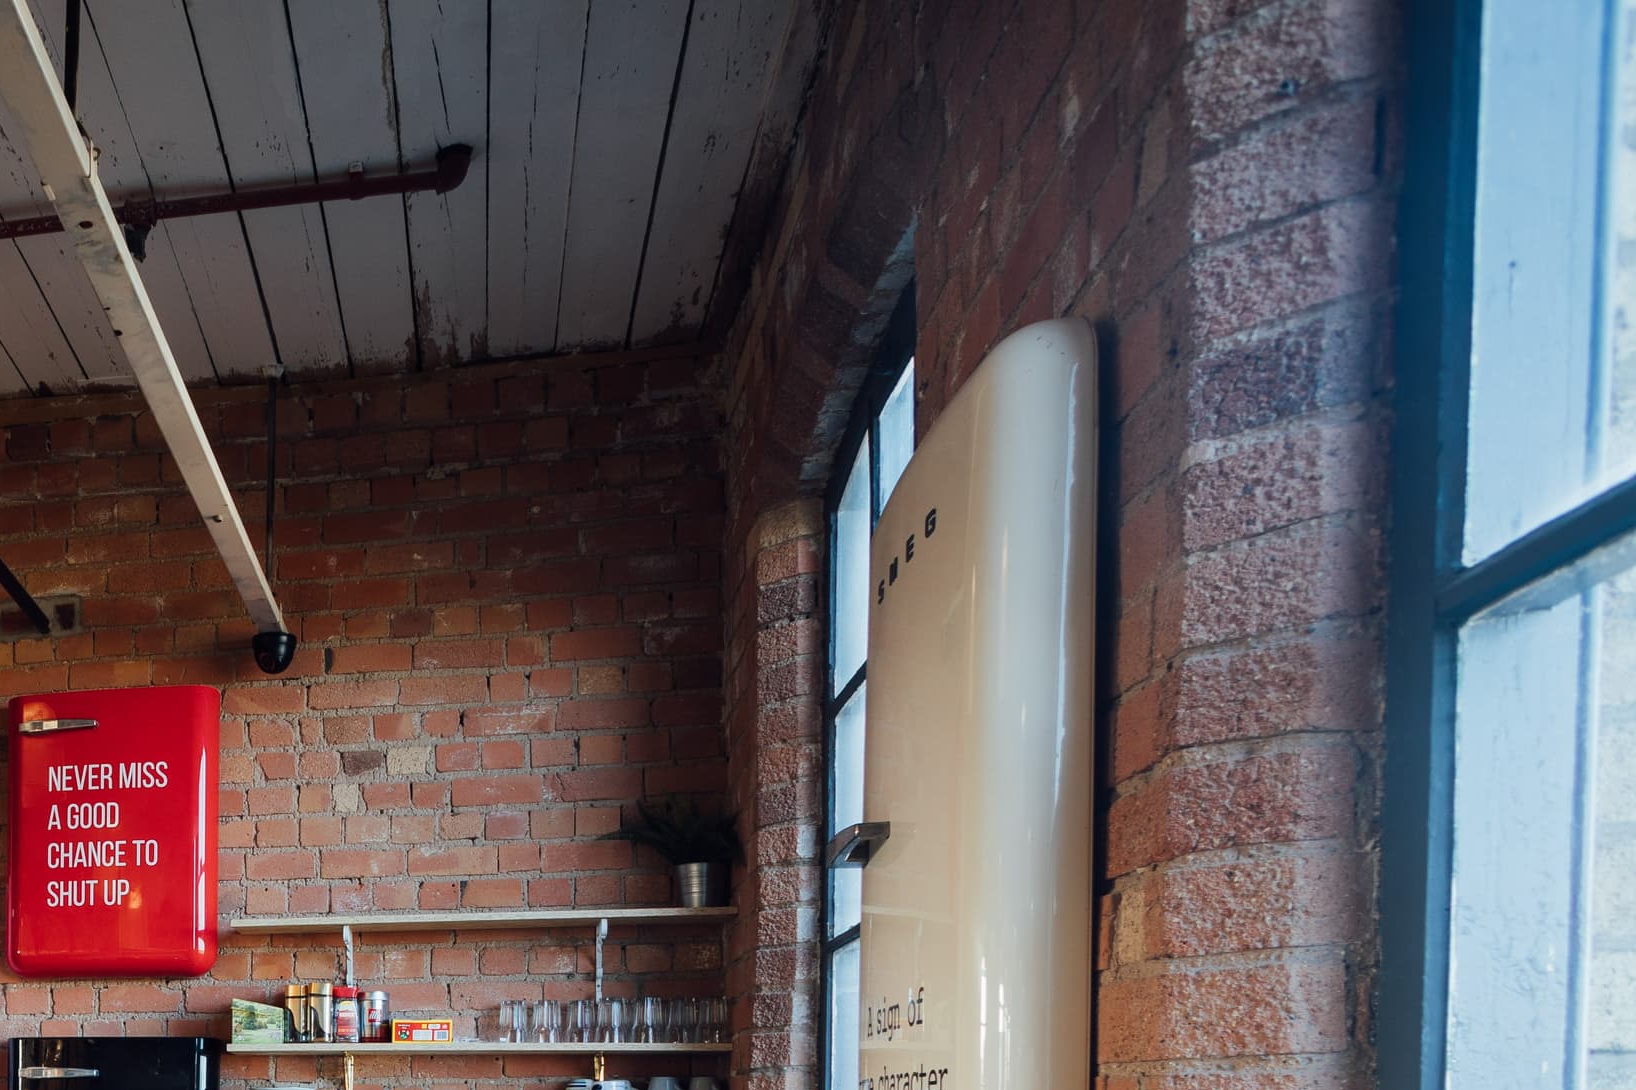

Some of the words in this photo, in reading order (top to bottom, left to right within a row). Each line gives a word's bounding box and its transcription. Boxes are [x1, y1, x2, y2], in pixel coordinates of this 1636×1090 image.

[878, 508, 936, 605] SMEG
[48, 763, 113, 792] NEVER
[118, 761, 168, 789] MISS
[47, 804, 62, 831] A
[67, 802, 120, 830] GOOD
[47, 840, 127, 869] CHANCE
[132, 839, 159, 867] TO
[46, 880, 98, 907] SHUT
[103, 879, 130, 906] UP
[867, 1007, 873, 1037] A
[877, 996, 900, 1041] sign
[908, 987, 924, 1027] of
